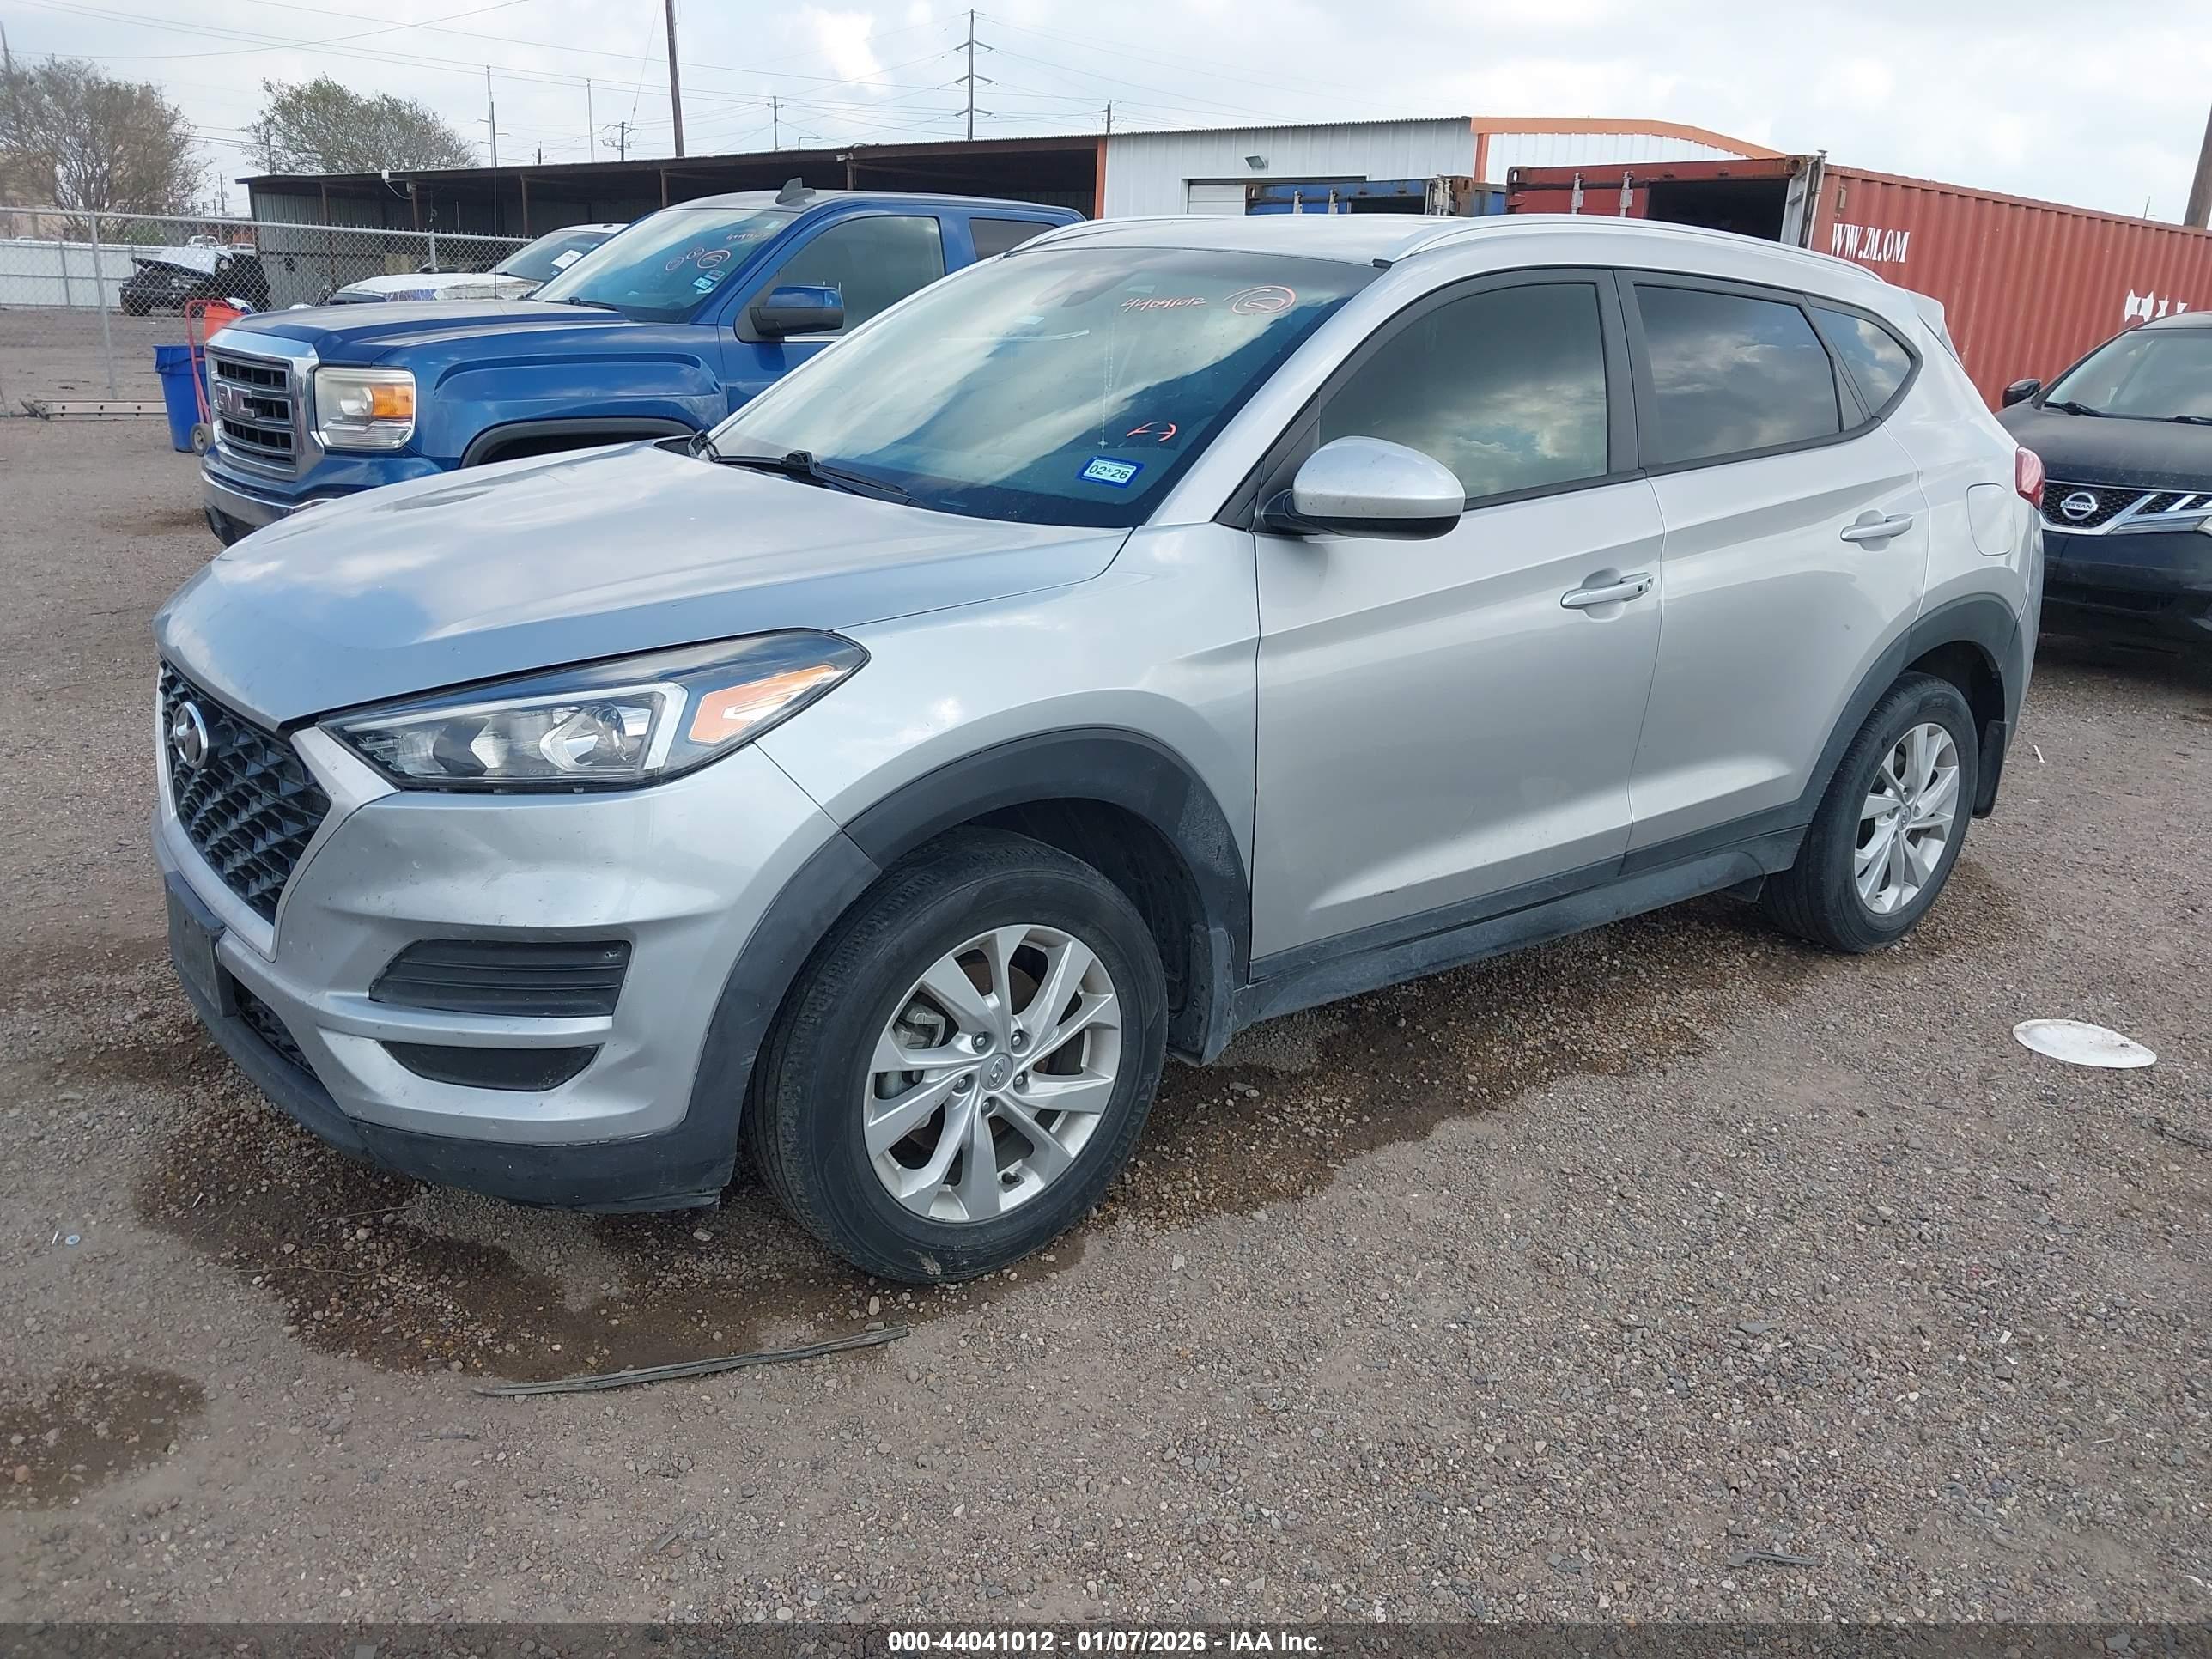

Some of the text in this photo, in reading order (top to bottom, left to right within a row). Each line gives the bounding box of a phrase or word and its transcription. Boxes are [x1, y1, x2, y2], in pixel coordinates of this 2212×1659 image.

[1120, 296, 1206, 313] 44041012
[213, 382, 256, 419] GMC
[1088, 465, 1107, 476] 02
[1109, 468, 1131, 479] 26
[2063, 501, 2094, 510] NISSAN
